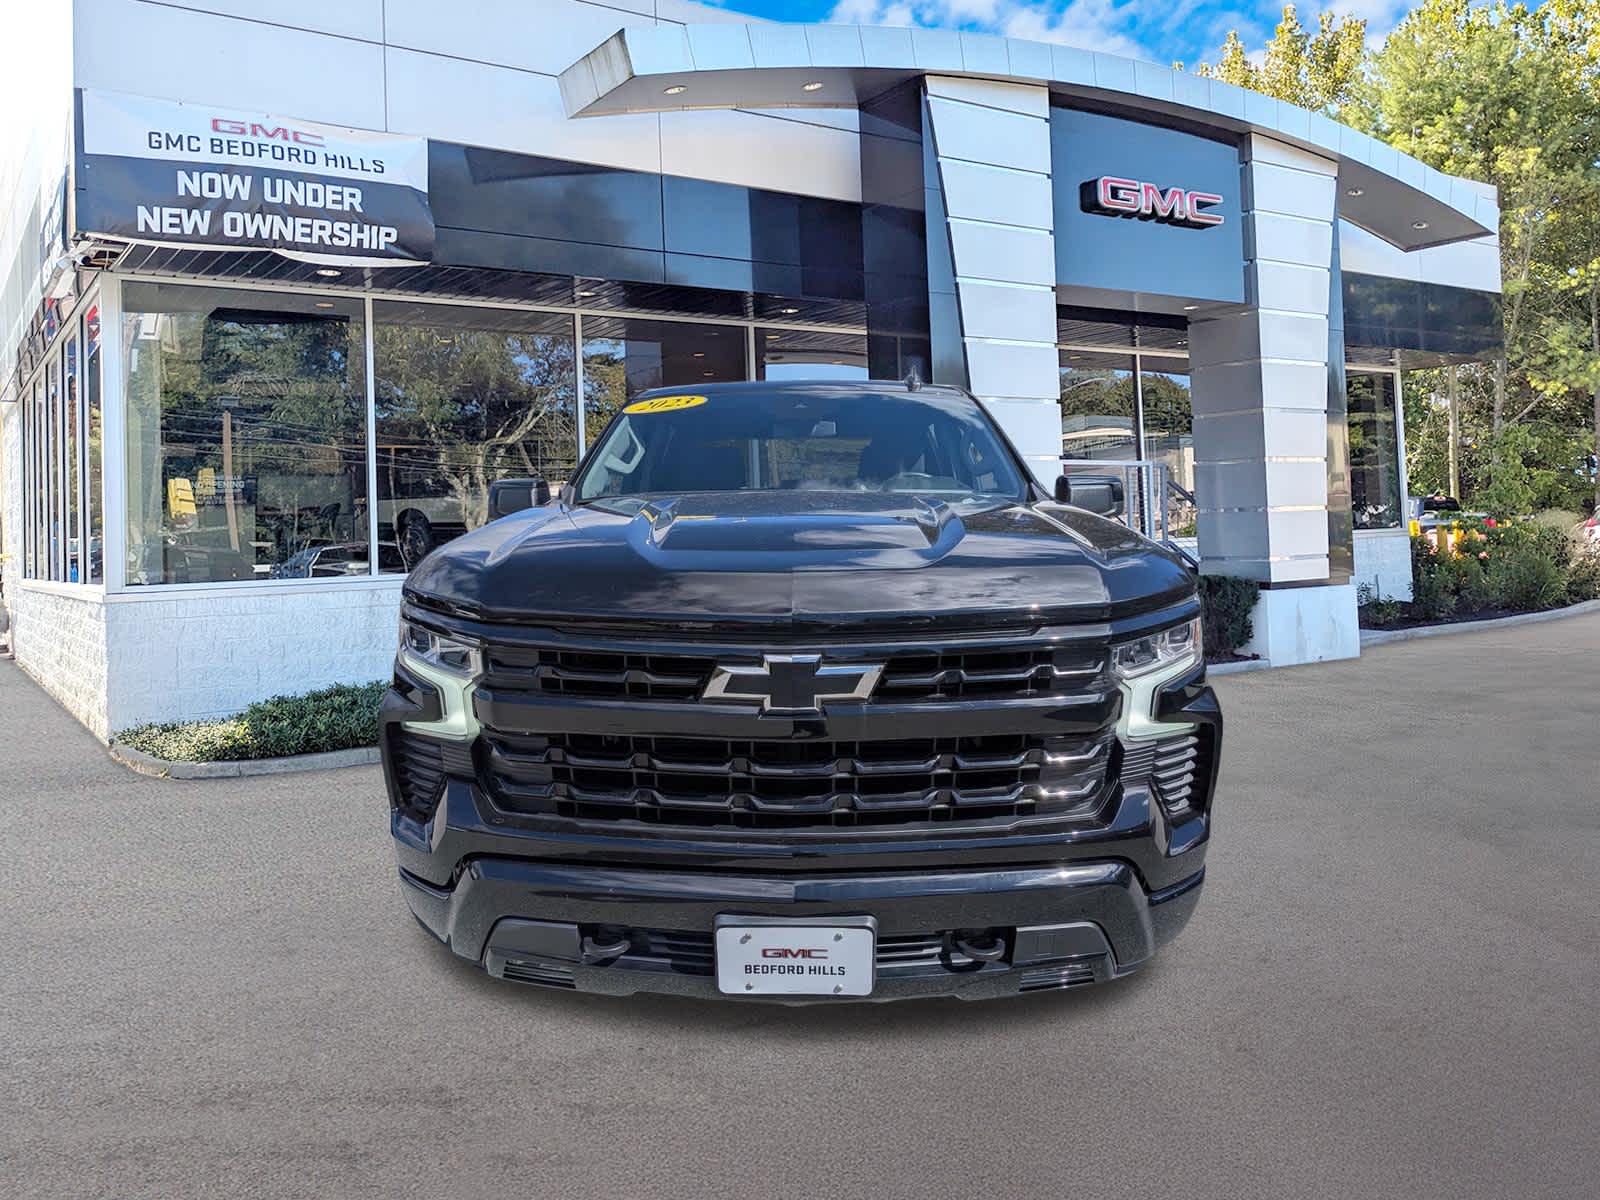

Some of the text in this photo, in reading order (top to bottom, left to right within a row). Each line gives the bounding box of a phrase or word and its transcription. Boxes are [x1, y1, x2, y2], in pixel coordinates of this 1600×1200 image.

[148, 131, 385, 174] GMC BEDFORD HILLS
[211, 118, 325, 147] GMC
[177, 170, 363, 212] NOW UNDER
[1097, 176, 1225, 225] GMC
[137, 206, 398, 250] NEW OWNERSHIP
[744, 964, 846, 976] BEDFORD HILLS
[761, 948, 829, 959] GMC
